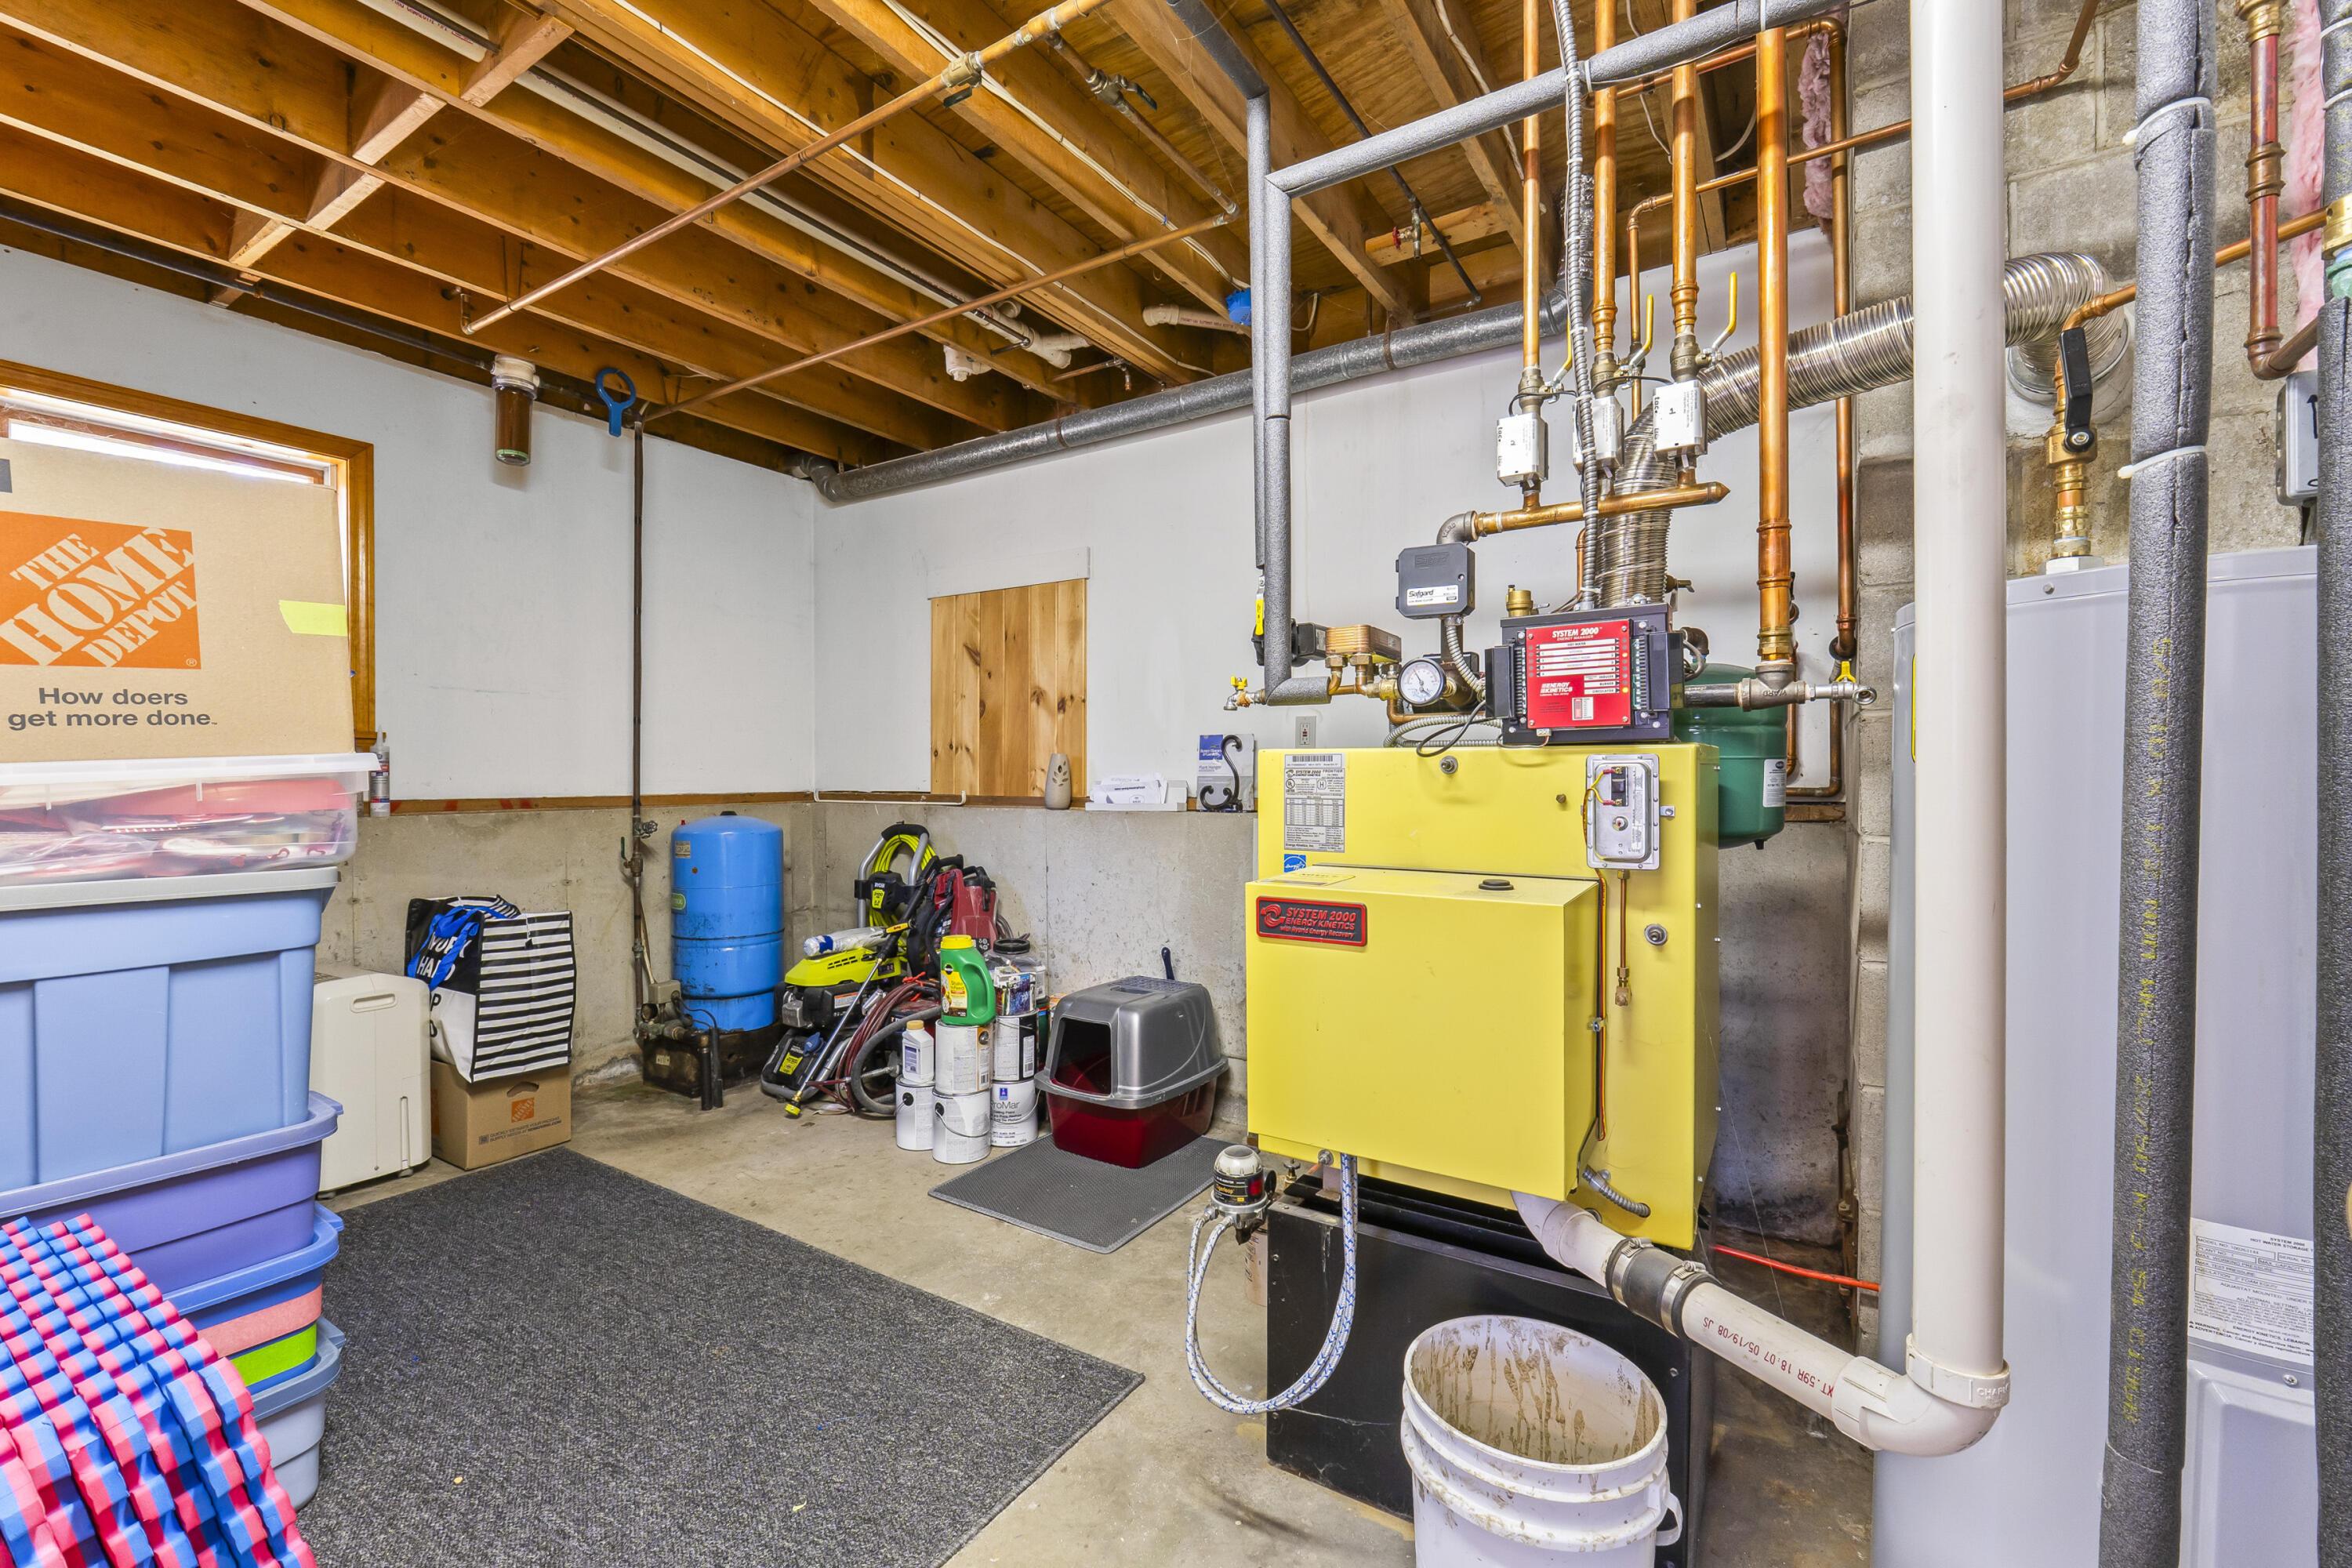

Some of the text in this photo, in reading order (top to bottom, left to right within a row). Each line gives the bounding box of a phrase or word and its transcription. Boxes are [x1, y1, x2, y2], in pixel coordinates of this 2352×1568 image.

[10, 533, 99, 590] THE
[0, 527, 194, 666] HOME
[1409, 590, 1434, 598] Safgard
[82, 580, 197, 667] DEPOT
[1552, 627, 1599, 638] SYSTEM 2000
[39, 688, 188, 705] How doers
[8, 710, 57, 731] get
[66, 711, 138, 726] more
[1286, 908, 1356, 923] SYSTEM 2000
[1286, 917, 1355, 931] ENERGY KINETICS
[2140, 898, 2159, 961] NOM
[1309, 927, 1328, 937] Energy
[1328, 931, 1355, 939] Recovery
[2220, 1282, 2251, 1292] AQUASTAT
[1702, 1316, 1715, 1329] JS
[1717, 1323, 1761, 1356] 05/19/08
[2252, 1336, 2286, 1347] Reproductive
[1764, 1350, 1793, 1375] 18:07
